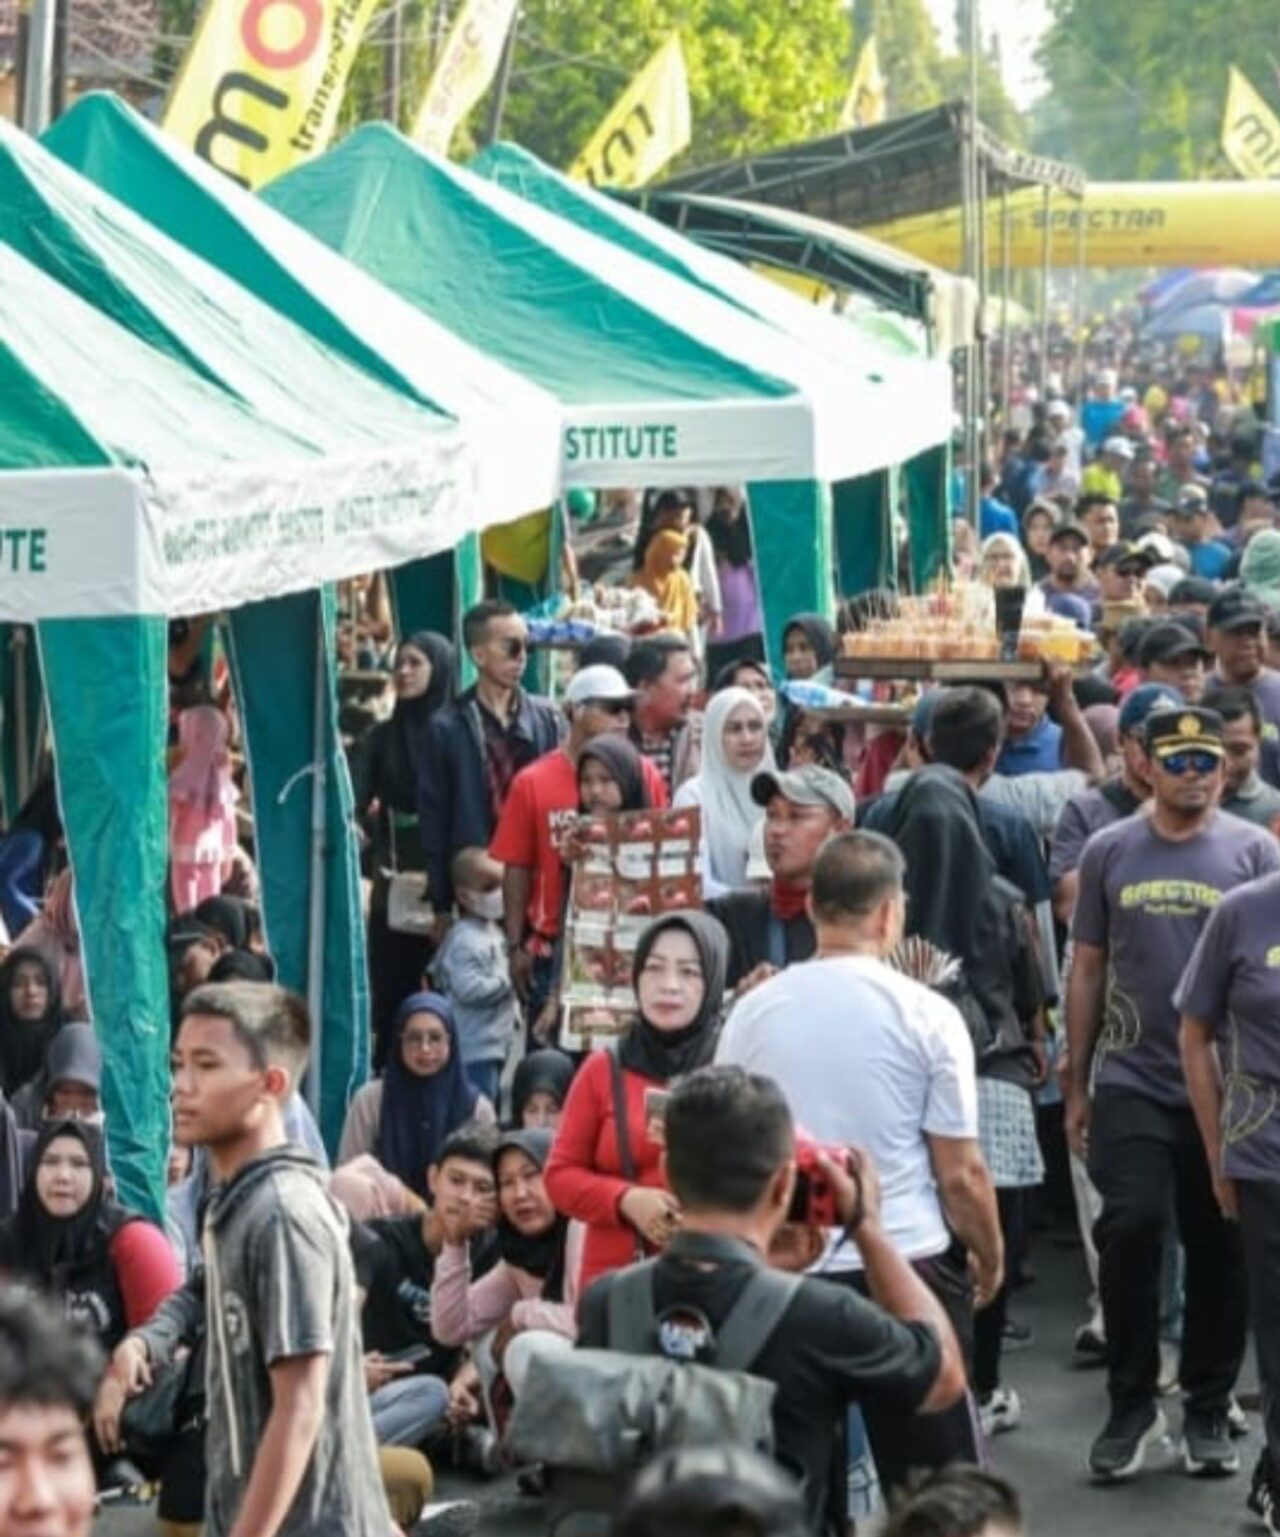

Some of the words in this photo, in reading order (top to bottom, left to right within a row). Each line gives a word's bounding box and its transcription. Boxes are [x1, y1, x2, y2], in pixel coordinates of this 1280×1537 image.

[1033, 209, 1166, 230] SPECTRA
[565, 425, 677, 460] STITUTE
[0, 528, 47, 573] TE
